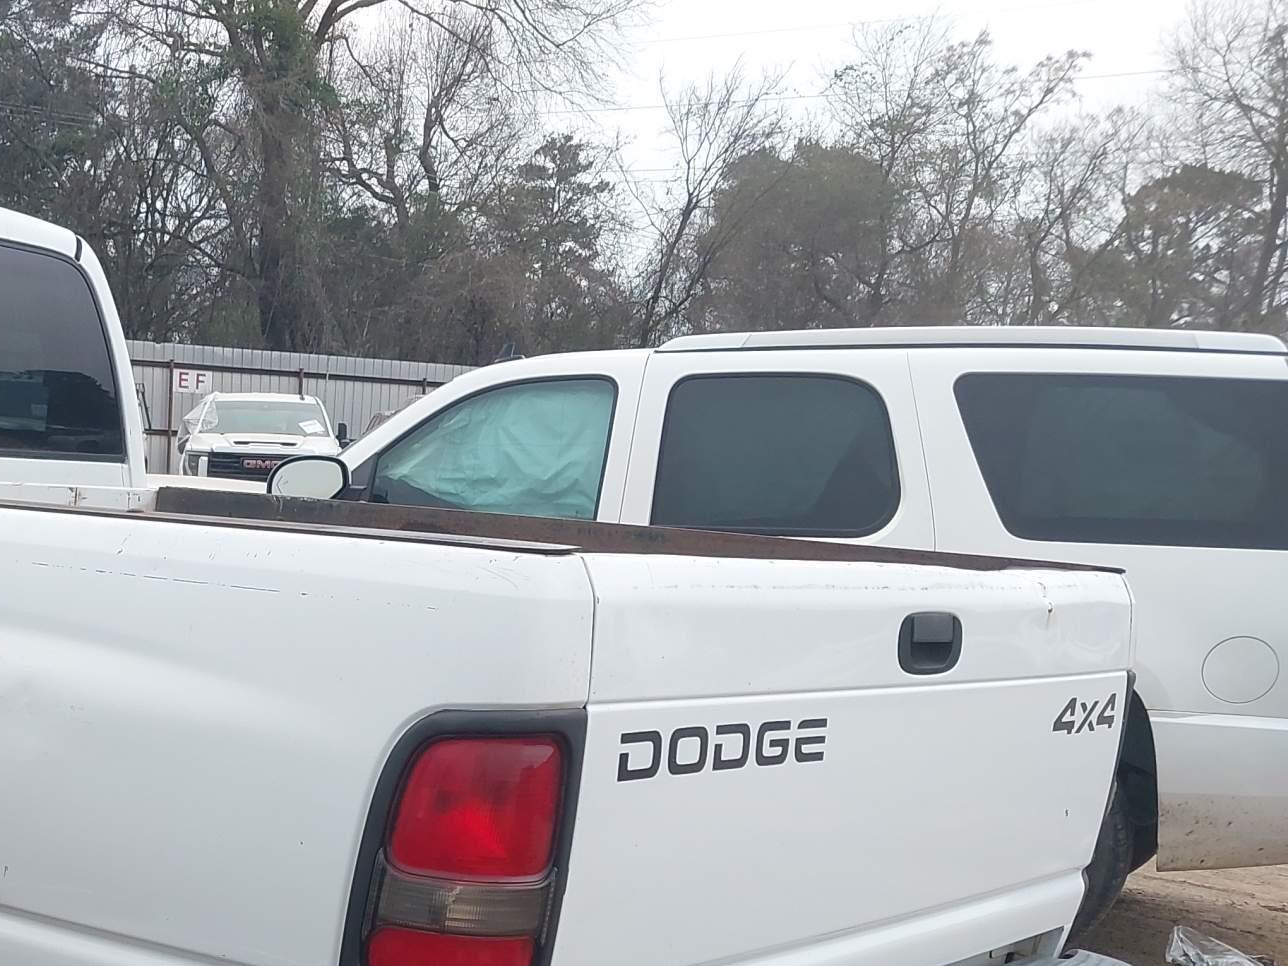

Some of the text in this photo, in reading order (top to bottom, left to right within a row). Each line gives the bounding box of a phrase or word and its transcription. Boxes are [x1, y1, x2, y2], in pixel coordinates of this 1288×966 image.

[178, 372, 207, 390] E F
[617, 718, 828, 782] DODGE
